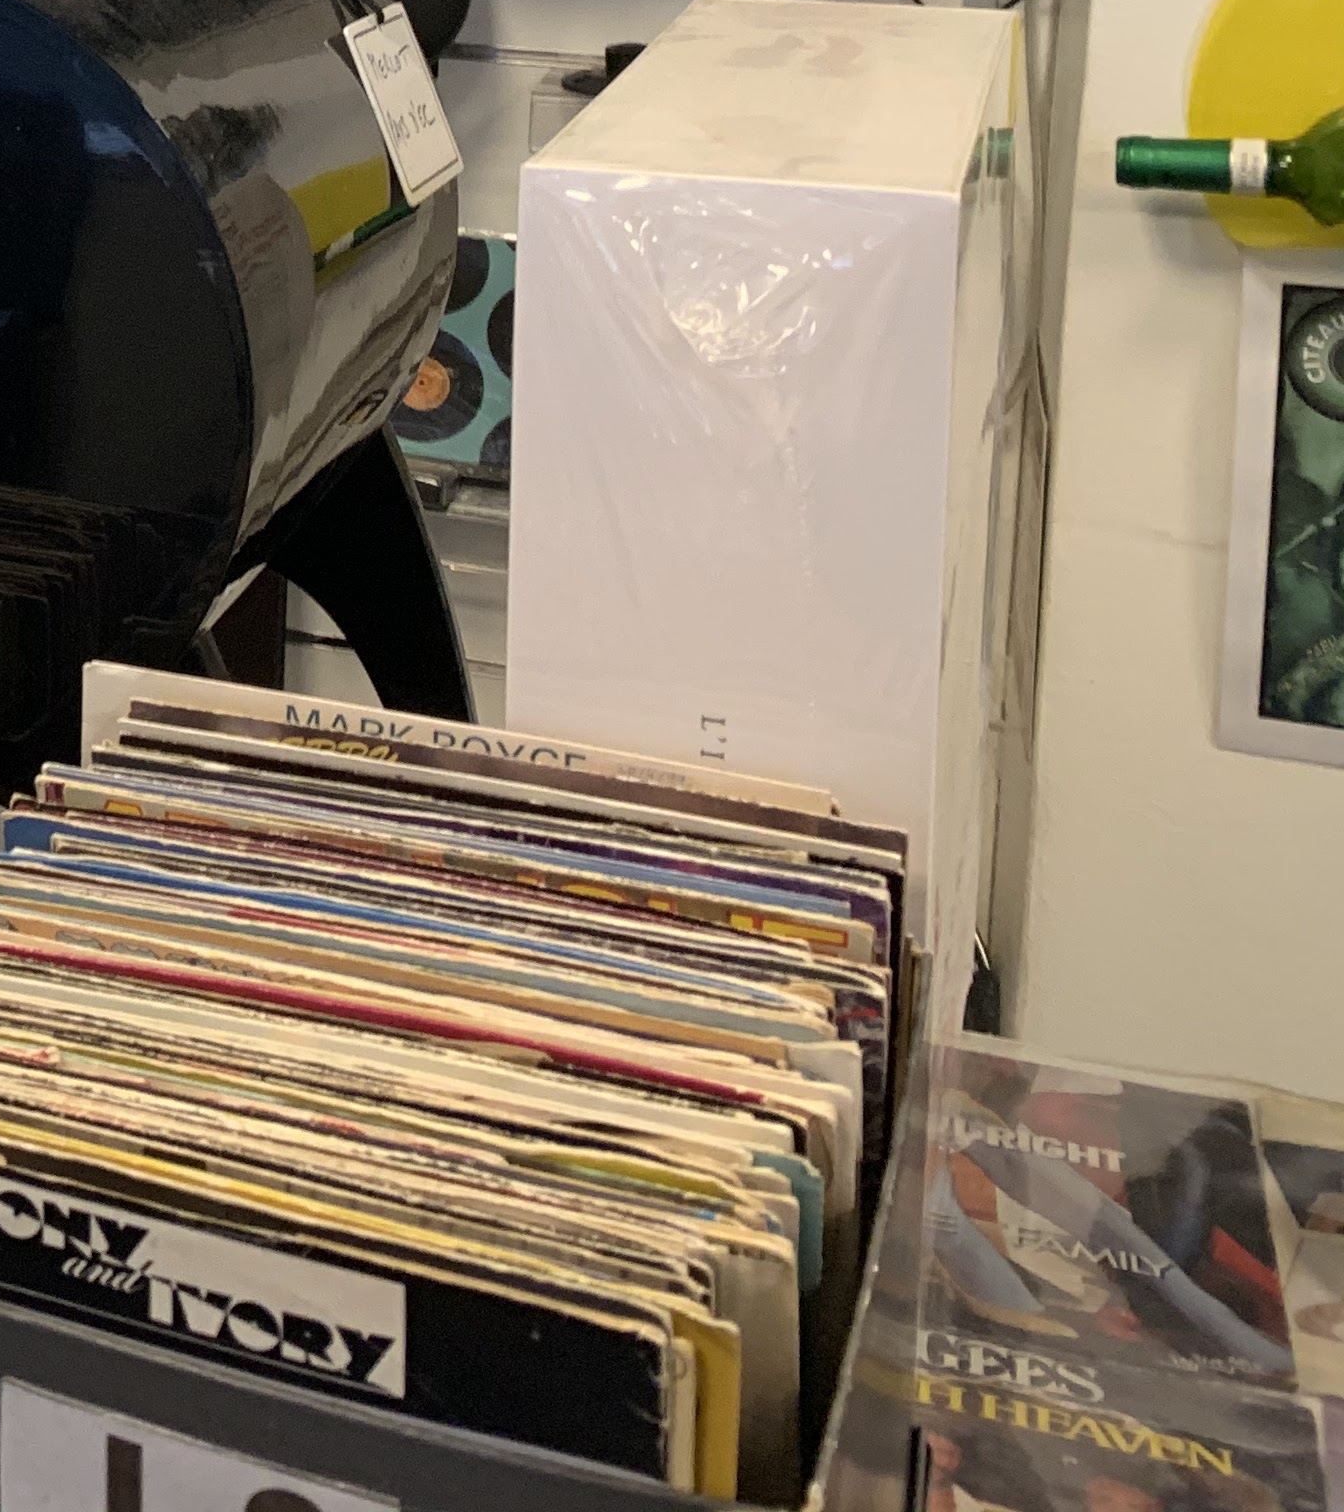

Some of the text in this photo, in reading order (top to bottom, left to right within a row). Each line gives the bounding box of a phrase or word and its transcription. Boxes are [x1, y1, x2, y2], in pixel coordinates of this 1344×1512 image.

[61, 1249, 150, 1294] and
[1010, 1220, 1176, 1279] FAMILY
[147, 1276, 400, 1383] IVORY
[980, 1394, 1234, 1476] HEAVEN
